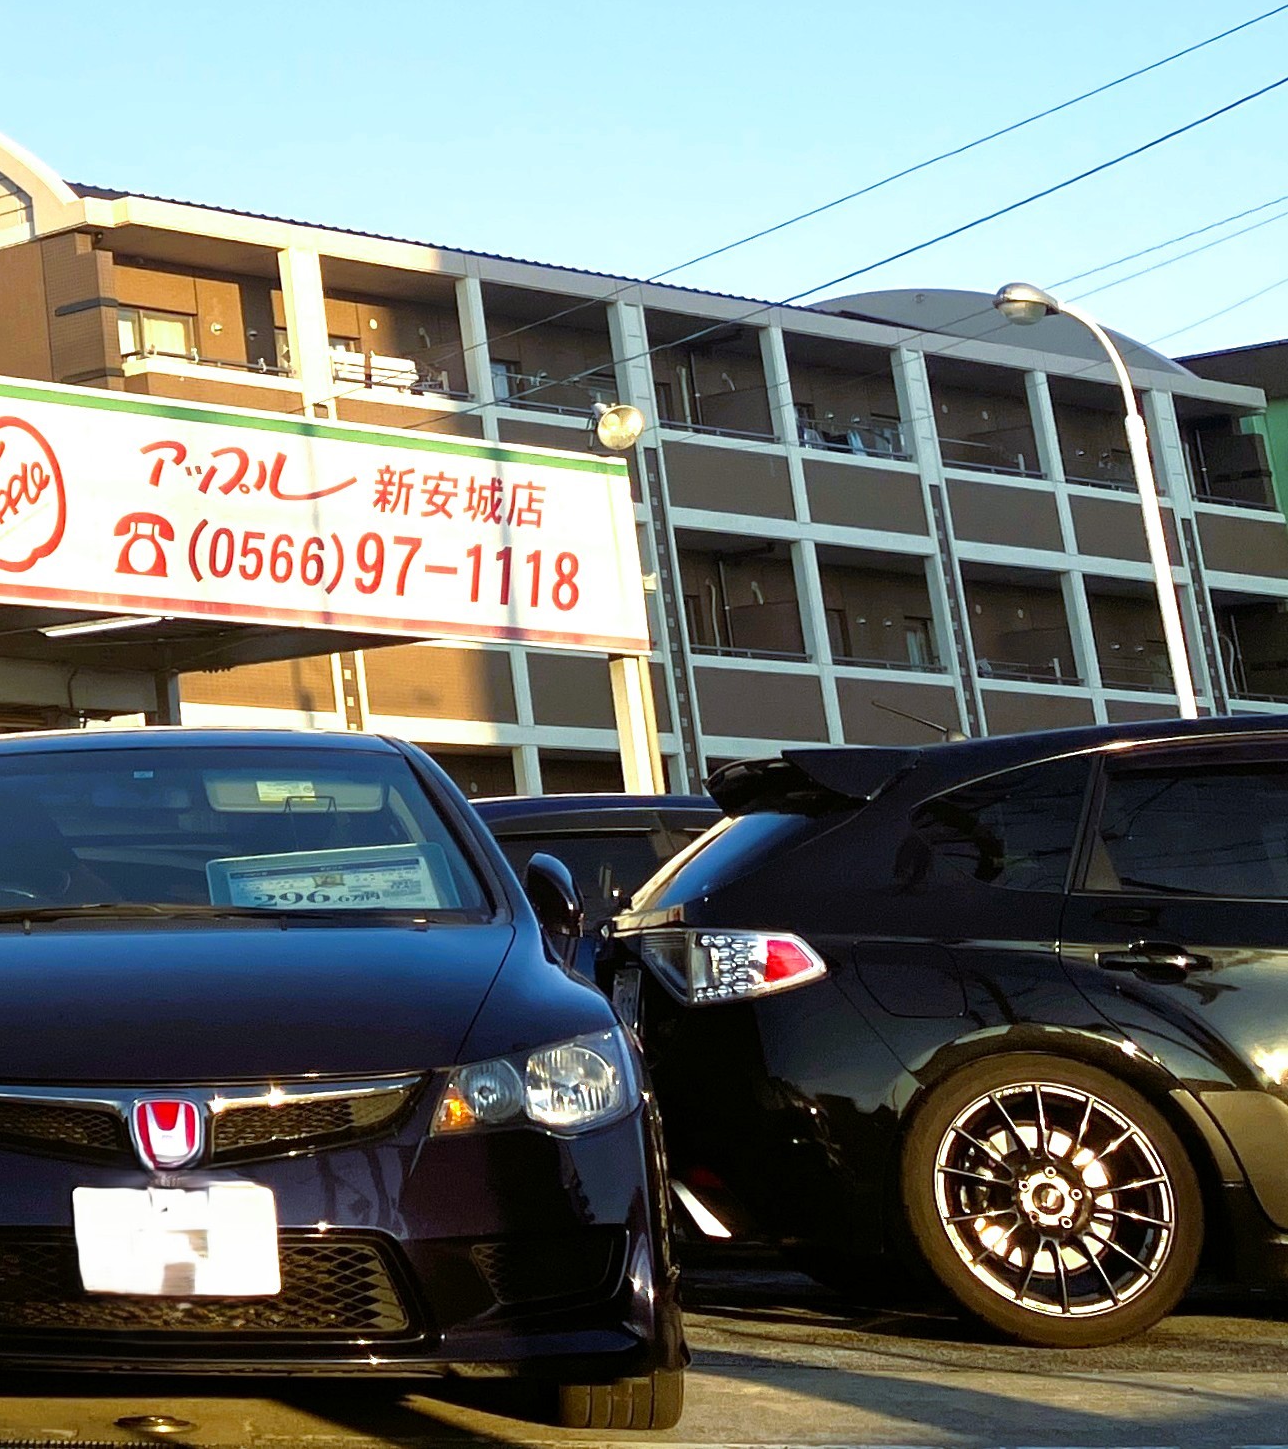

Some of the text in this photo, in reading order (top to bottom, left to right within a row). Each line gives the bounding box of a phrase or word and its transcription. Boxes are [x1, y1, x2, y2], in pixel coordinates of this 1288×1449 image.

[140, 440, 547, 529] アップル 新安城店
[188, 518, 580, 612] (0566)97-1118
